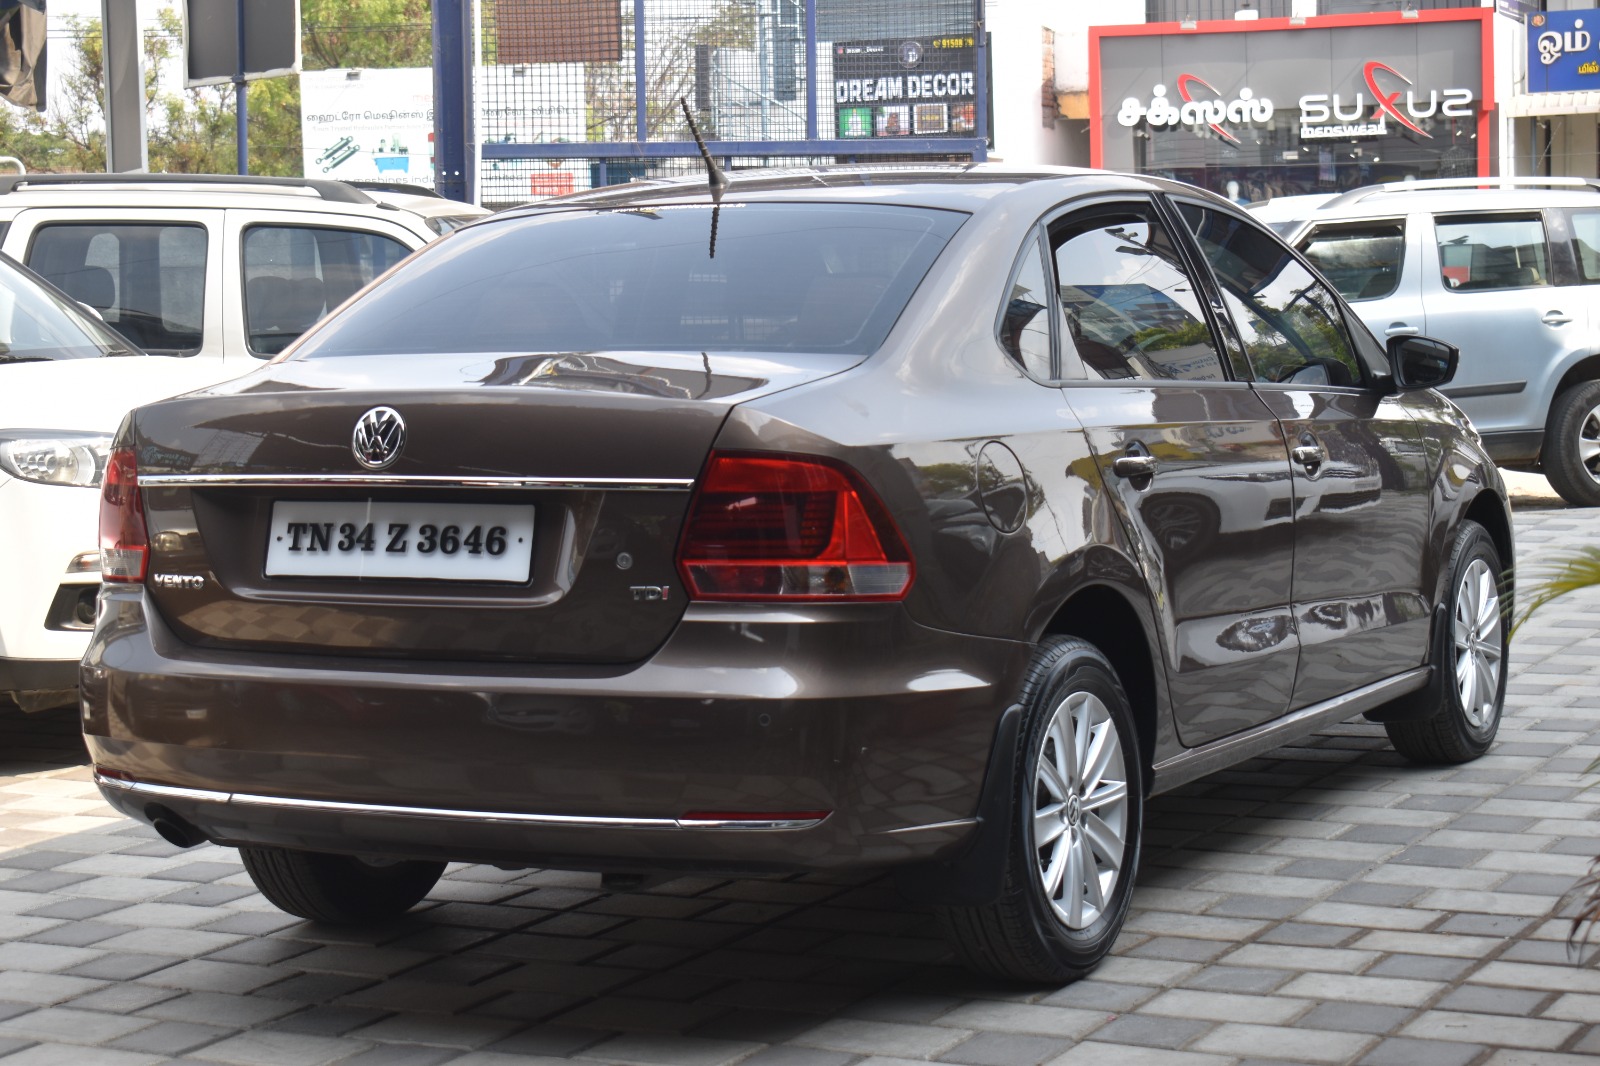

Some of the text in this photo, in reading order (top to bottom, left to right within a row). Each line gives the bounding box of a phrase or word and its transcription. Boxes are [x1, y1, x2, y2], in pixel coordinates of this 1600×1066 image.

[1538, 18, 1591, 65] ஓம்
[836, 71, 975, 103] DREAM DECOR
[386, 524, 410, 553] Z
[417, 525, 508, 556] 3646
[153, 573, 205, 589] VENTO
[629, 585, 670, 600] TDI
